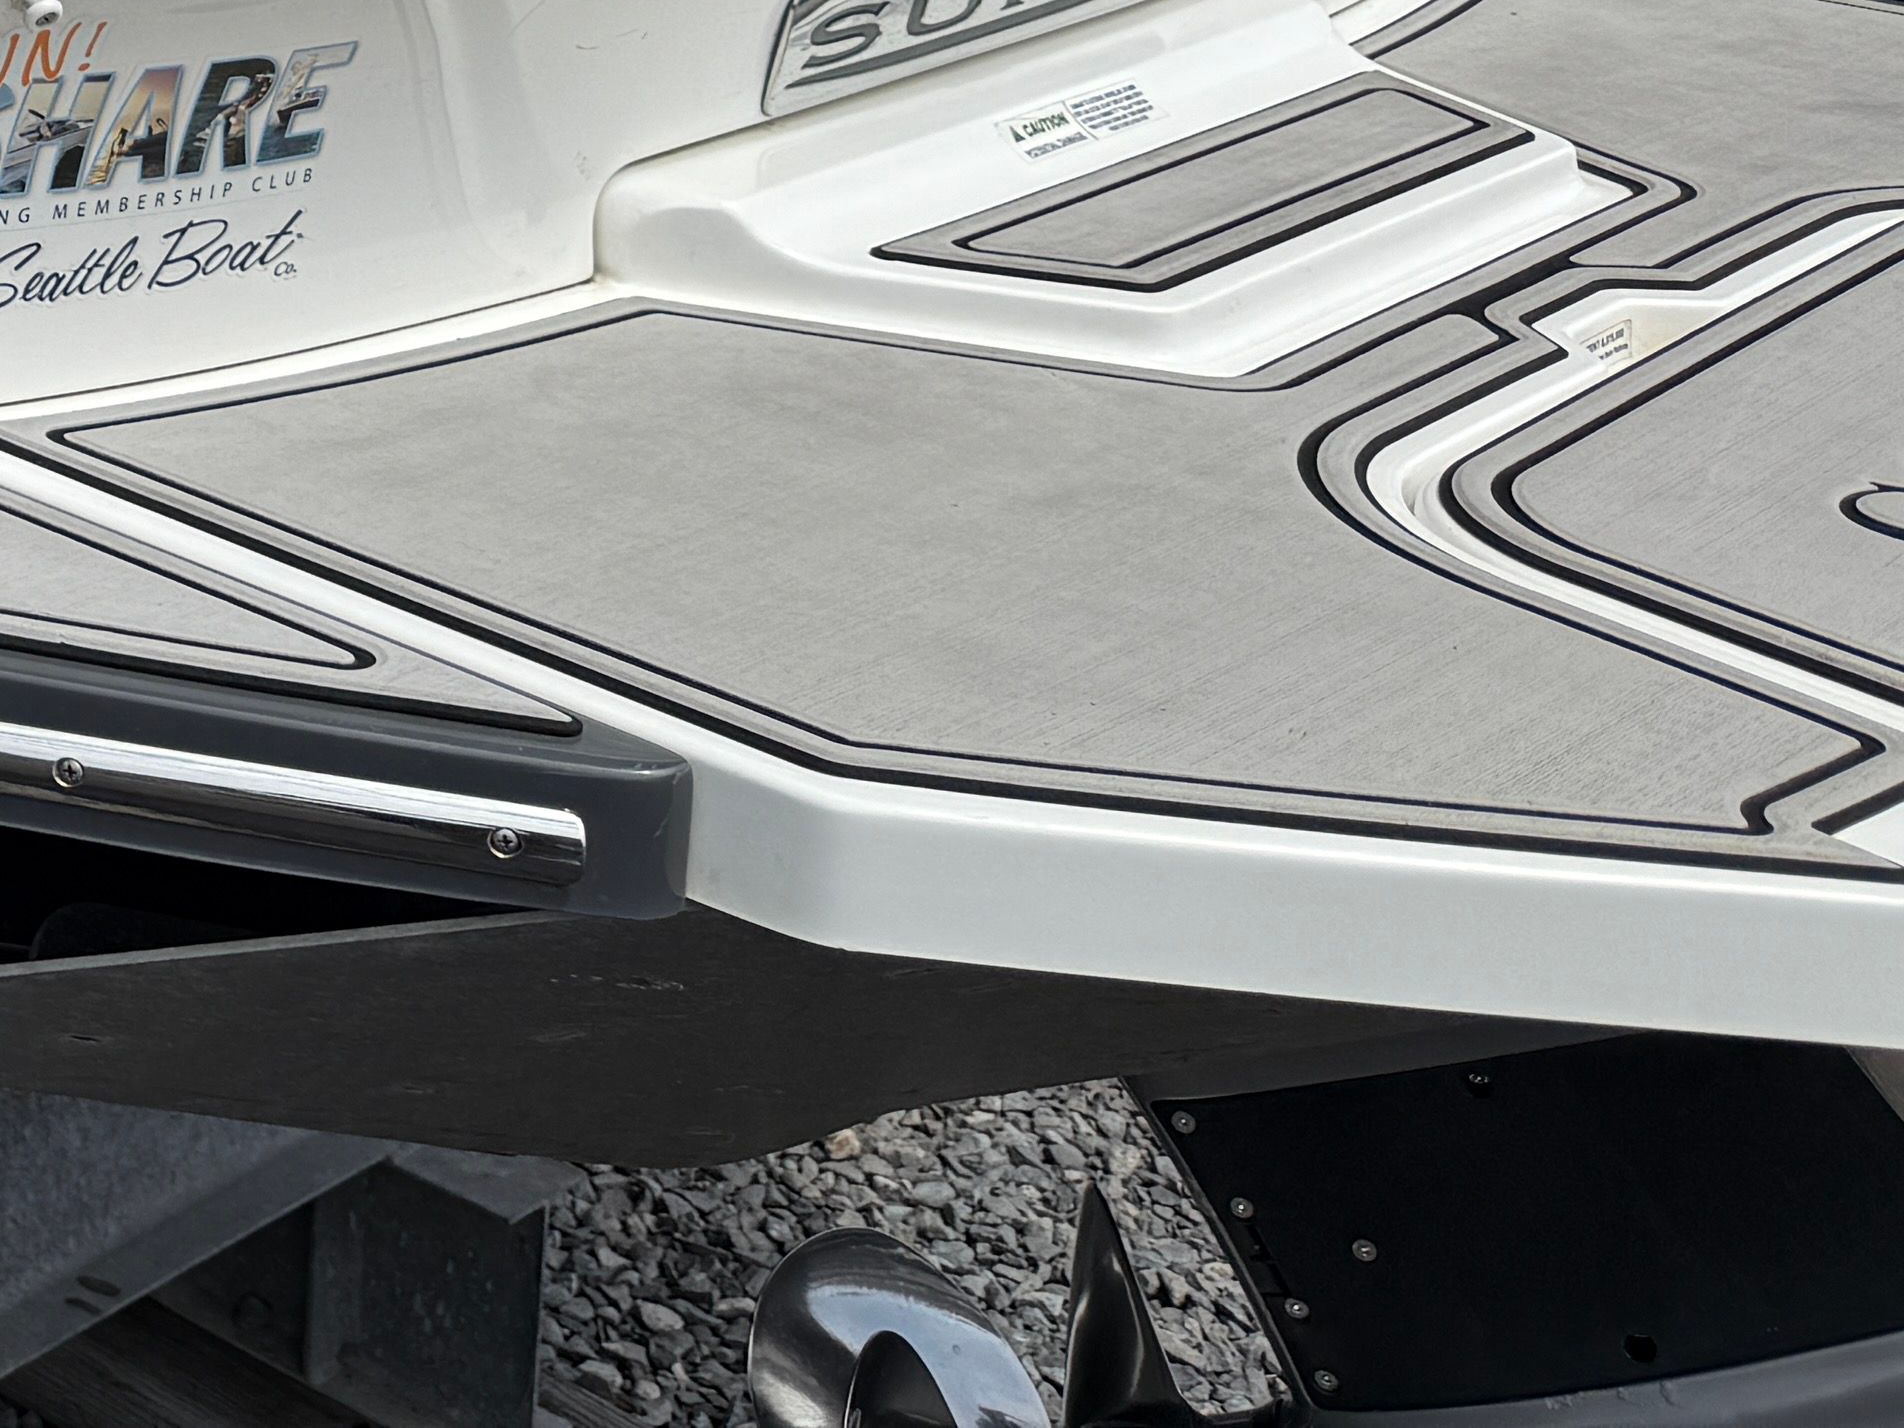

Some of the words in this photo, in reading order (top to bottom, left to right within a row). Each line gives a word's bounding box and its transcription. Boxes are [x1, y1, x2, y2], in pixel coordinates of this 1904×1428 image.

[1022, 111, 1070, 138] CAUTION
[52, 181, 234, 220] MEMBERSHIP
[252, 167, 315, 193] CLUB
[147, 209, 302, 290] Boat
